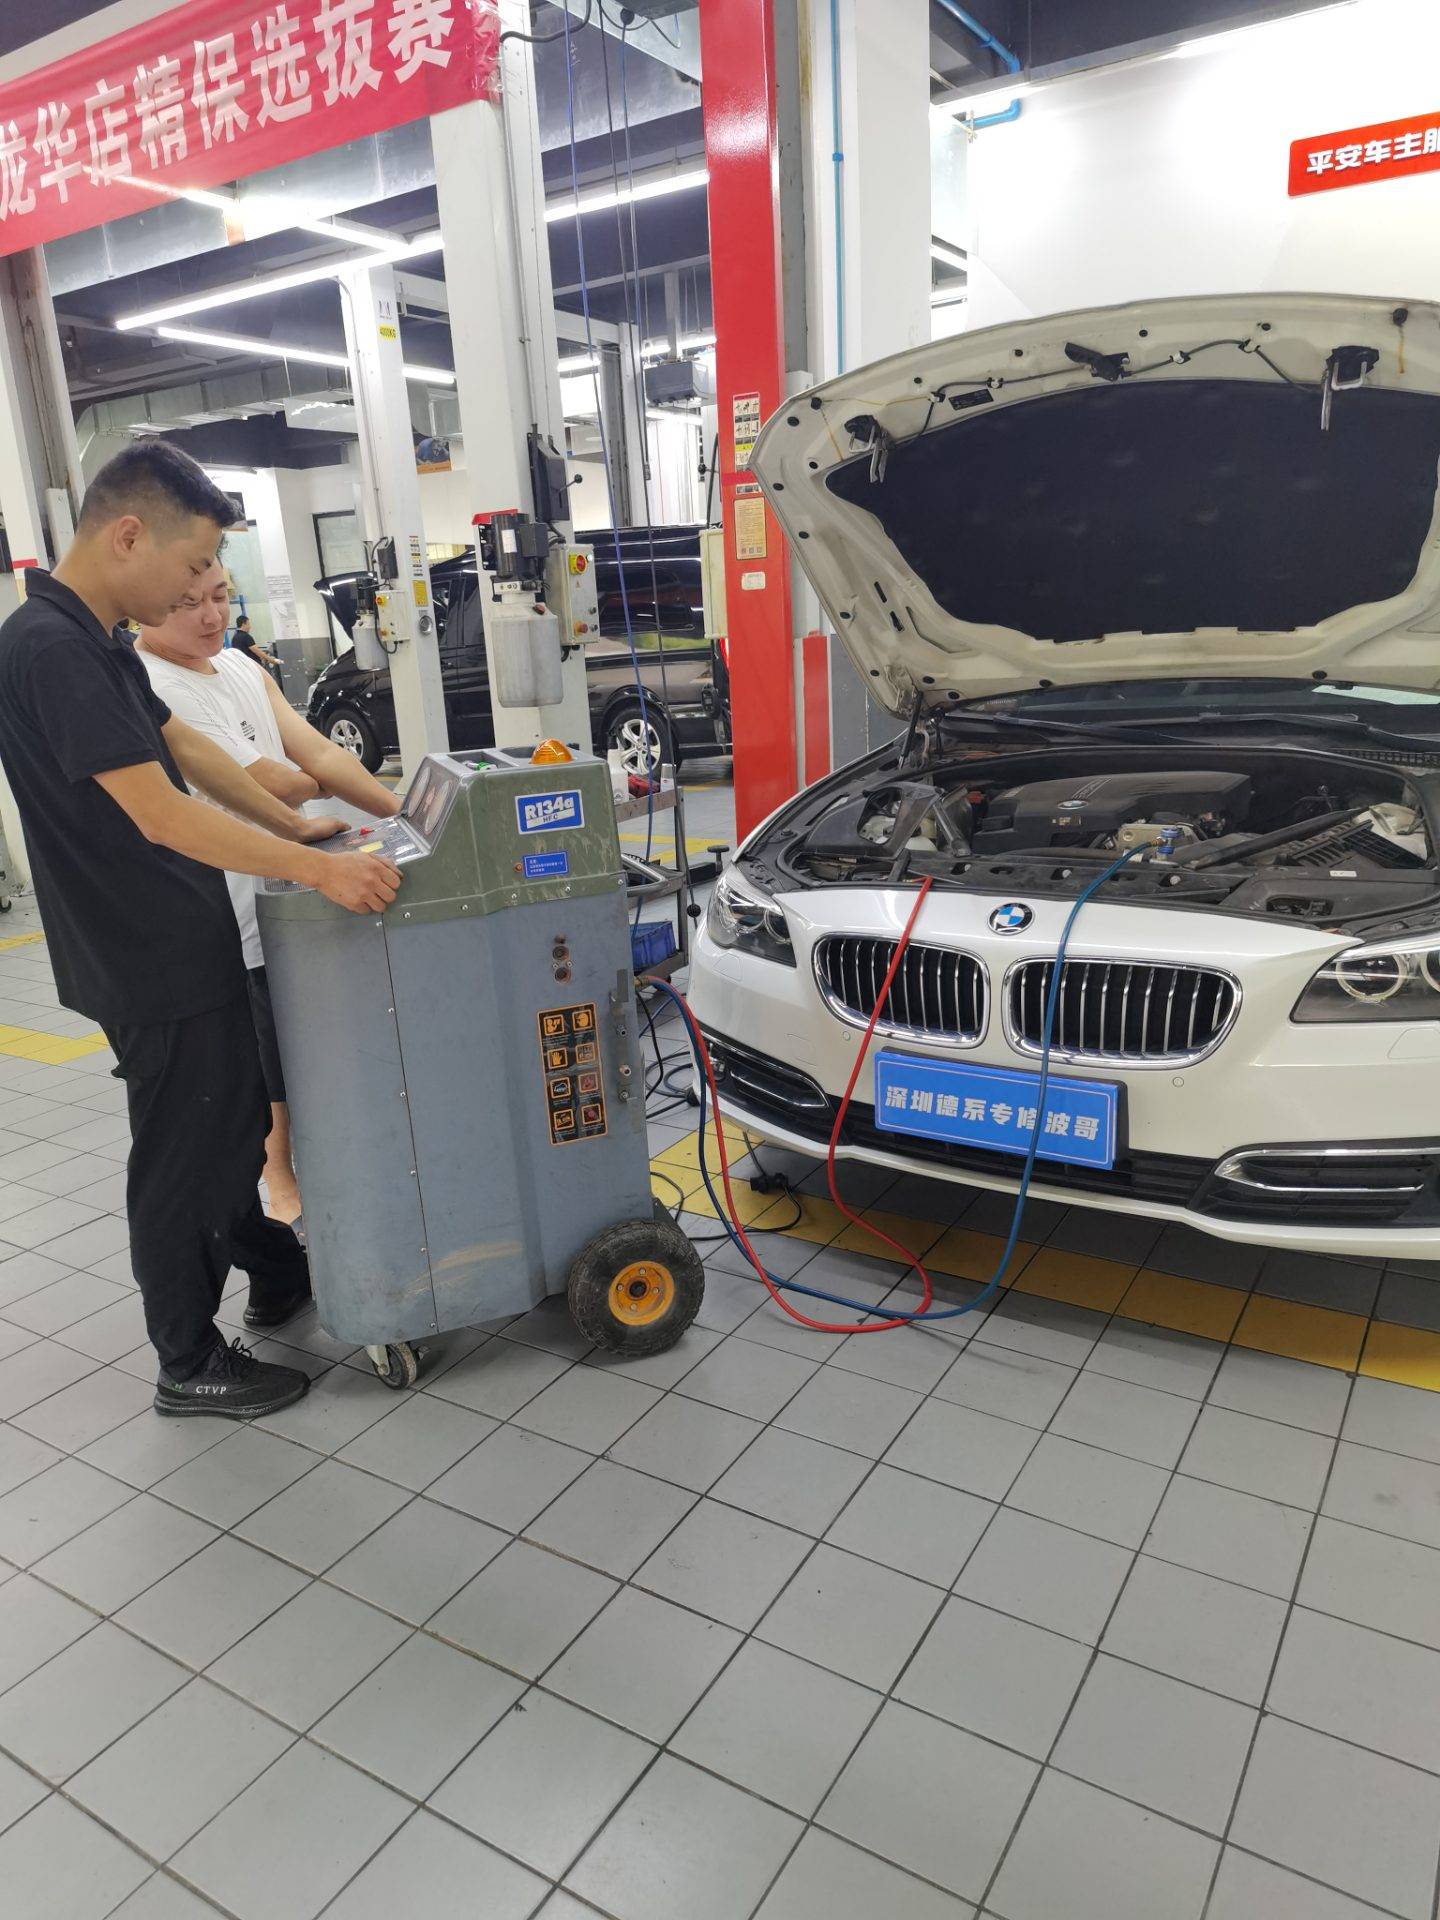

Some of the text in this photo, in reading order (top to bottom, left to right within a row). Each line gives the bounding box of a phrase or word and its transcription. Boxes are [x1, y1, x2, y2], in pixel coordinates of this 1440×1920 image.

[525, 796, 575, 820] R134a
[884, 1085, 1100, 1141] 深圳德系专修波哥
[195, 1385, 227, 1395] CTVP
